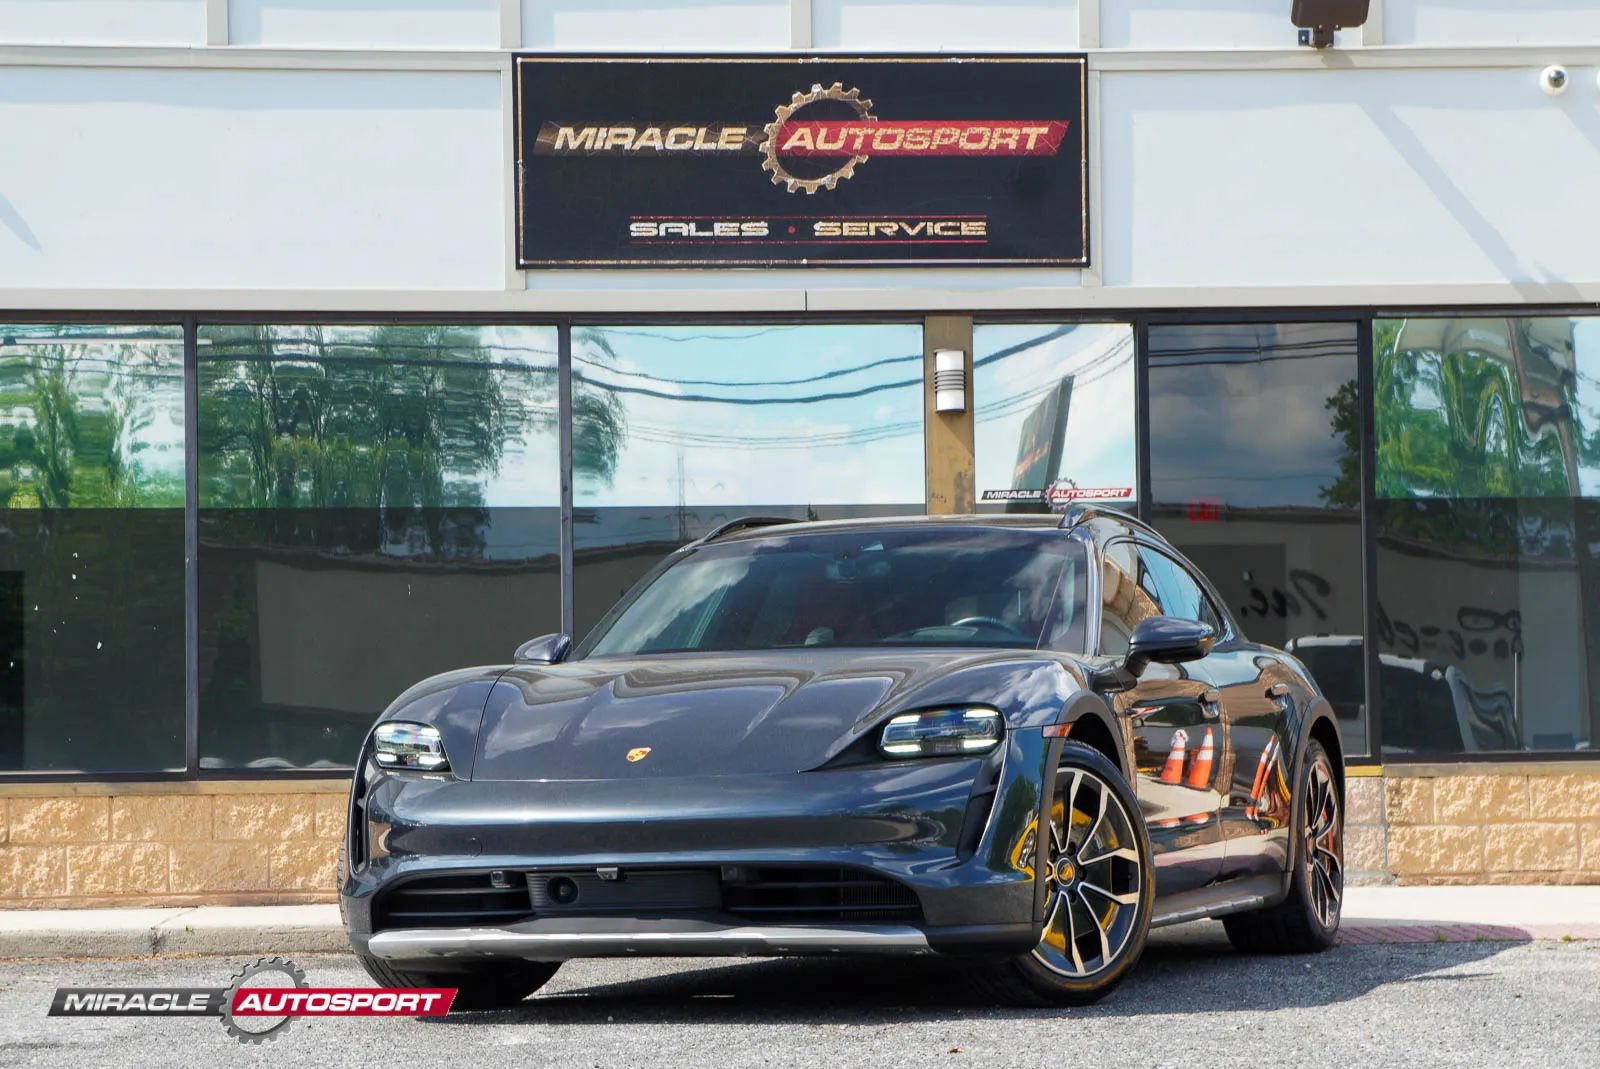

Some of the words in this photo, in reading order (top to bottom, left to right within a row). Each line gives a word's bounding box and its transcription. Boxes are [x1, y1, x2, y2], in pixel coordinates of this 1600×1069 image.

[554, 127, 747, 151] MIRACLE
[782, 126, 1050, 151] AUTOSPORT
[629, 221, 769, 238] SALES
[813, 220, 988, 237] SERVICE
[986, 490, 1041, 499] MIRACLE
[1051, 488, 1128, 497] AUTOSPORT
